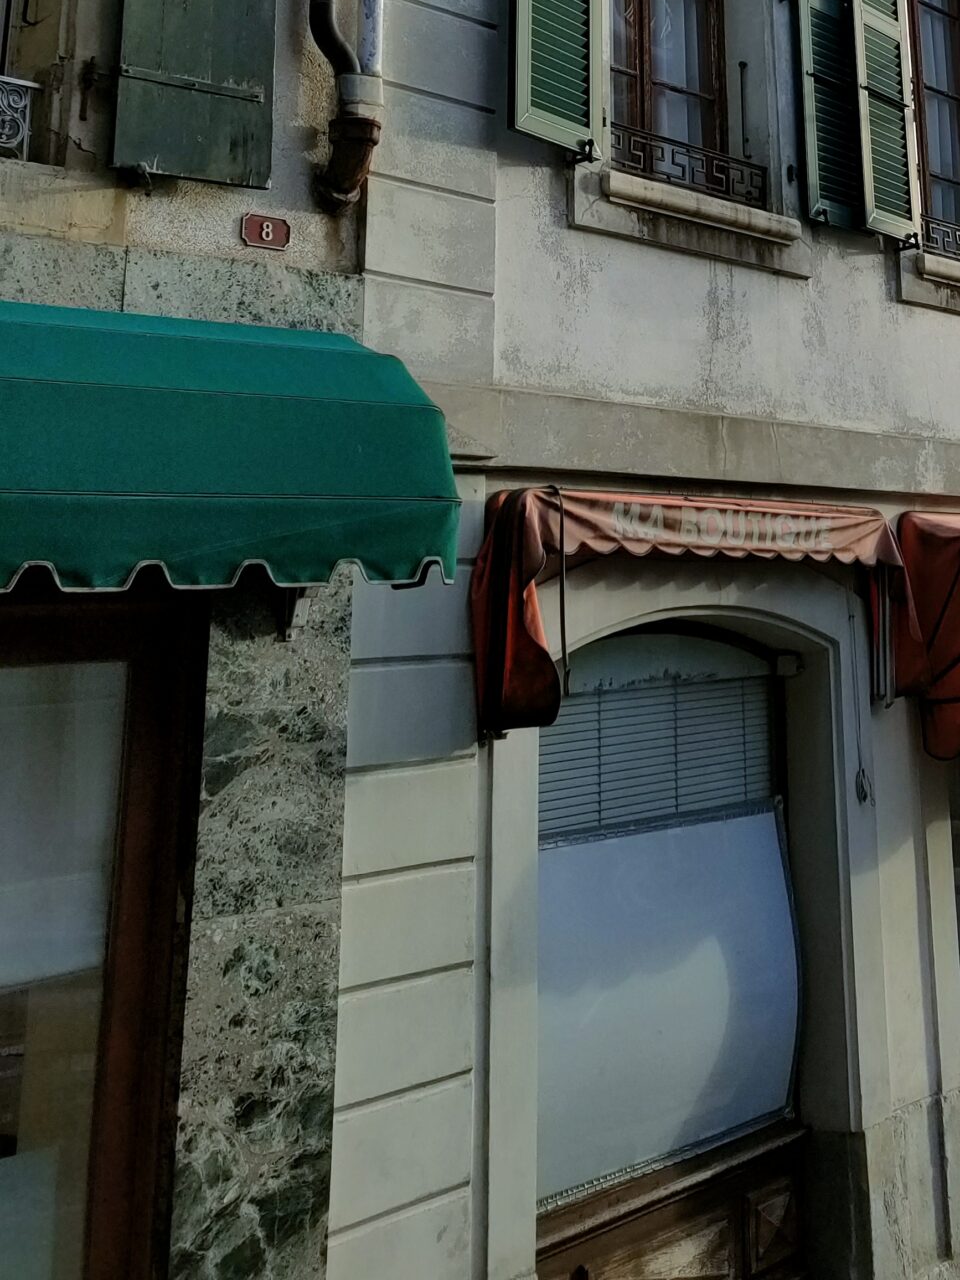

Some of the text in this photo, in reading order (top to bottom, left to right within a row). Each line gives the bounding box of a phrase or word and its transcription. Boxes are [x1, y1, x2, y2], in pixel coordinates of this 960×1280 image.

[262, 222, 273, 241] 8
[612, 502, 832, 549] MA BOUTIQUE
